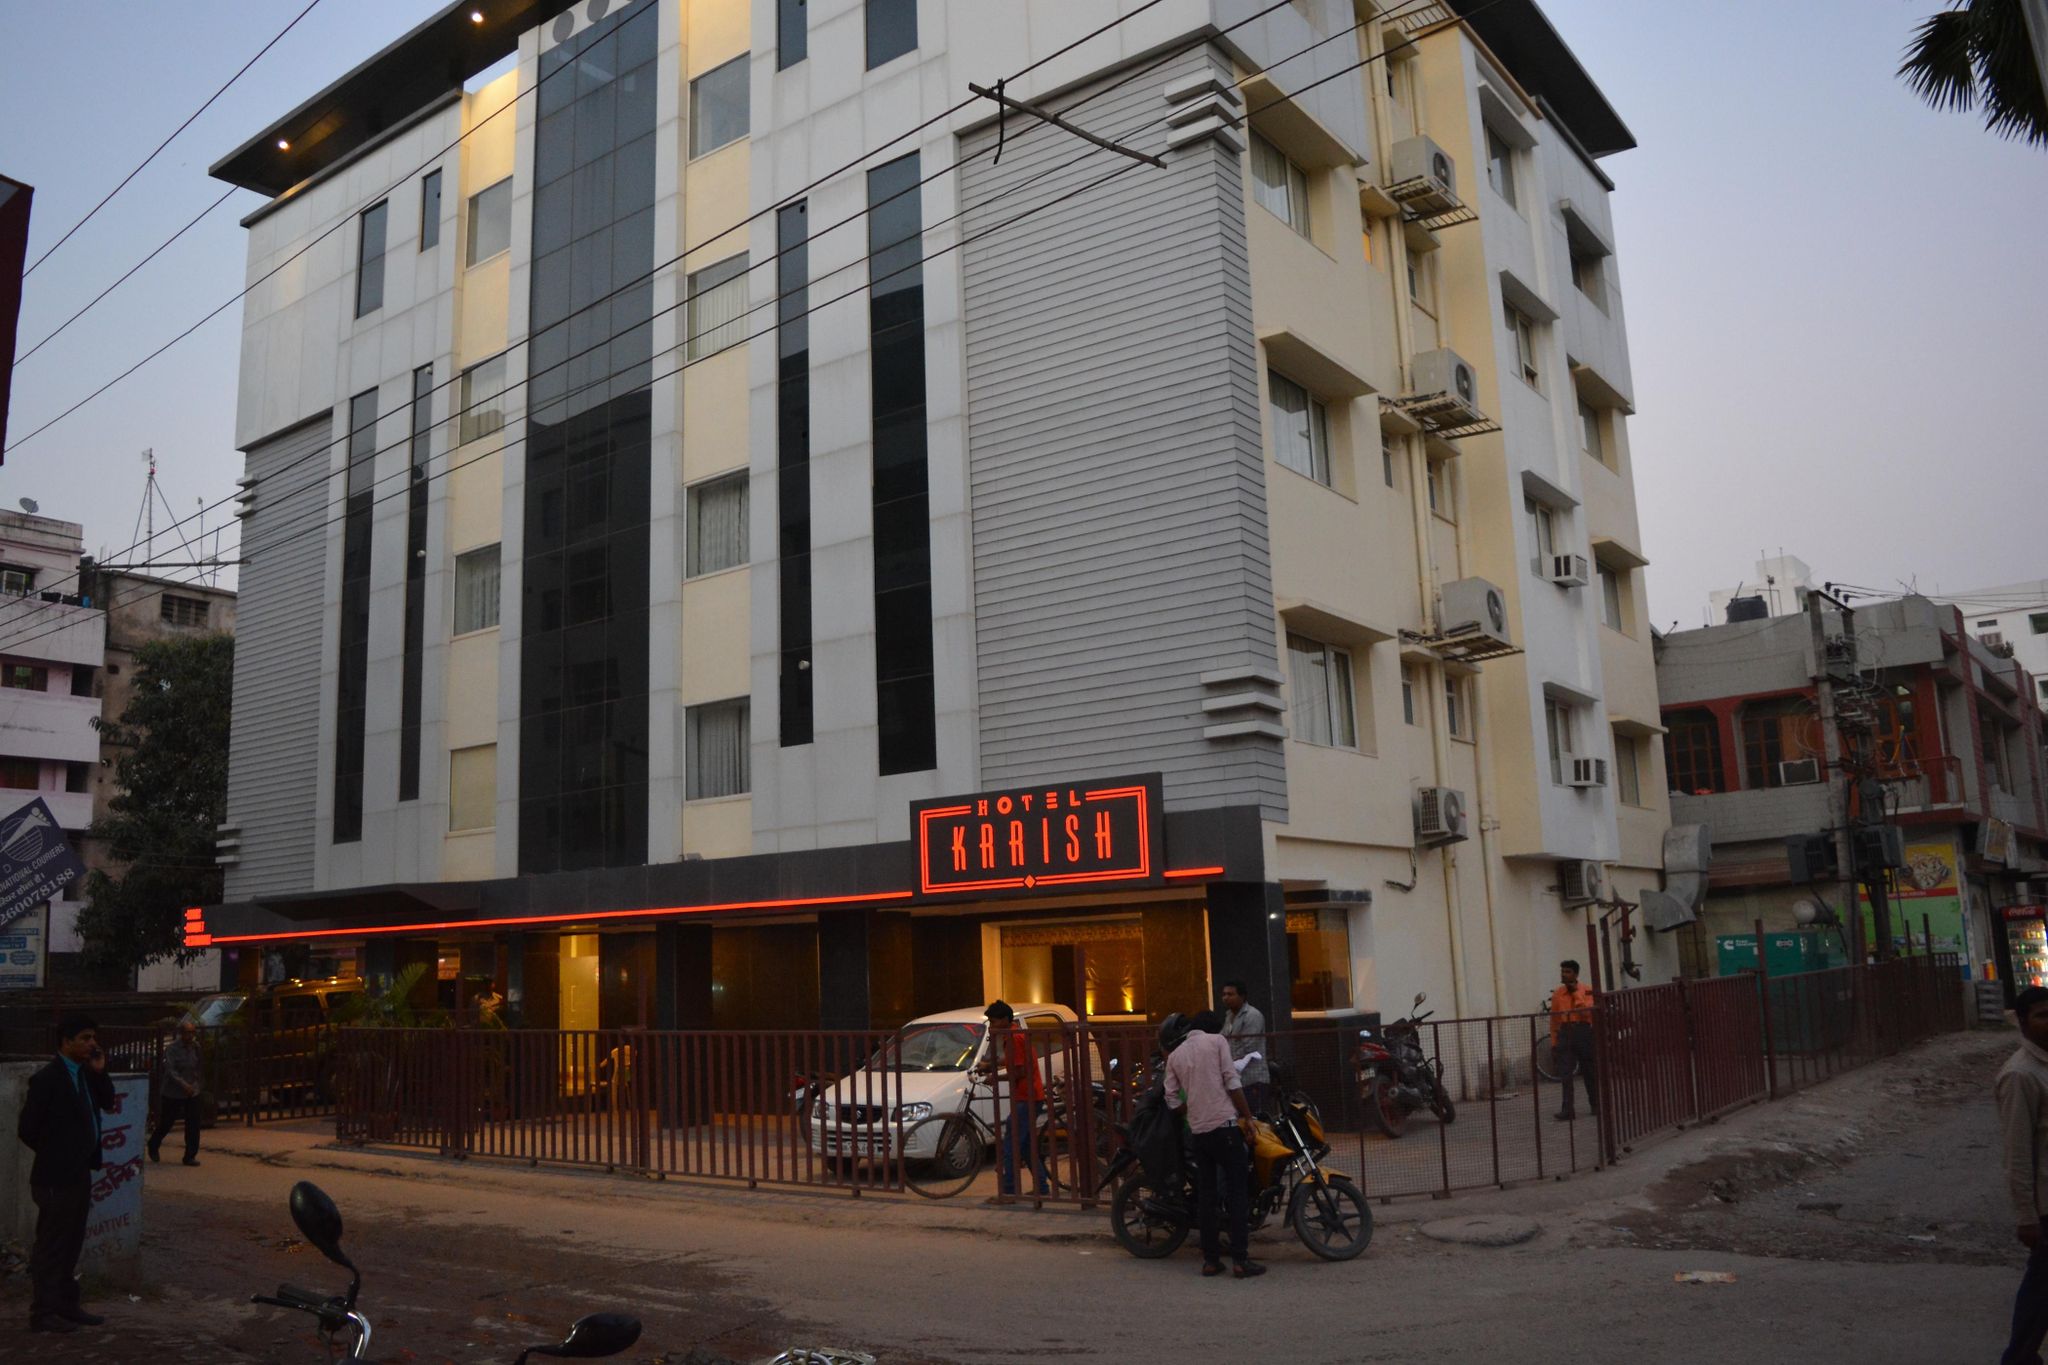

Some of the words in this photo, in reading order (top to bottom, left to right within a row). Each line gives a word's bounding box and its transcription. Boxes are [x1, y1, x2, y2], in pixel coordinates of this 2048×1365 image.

[977, 790, 1081, 816] HOTEL
[0, 866, 32, 892] NATIONAL
[32, 843, 66, 869] COURIERS
[0, 868, 75, 925] 260078188
[86, 1212, 129, 1238] OVATIVE
